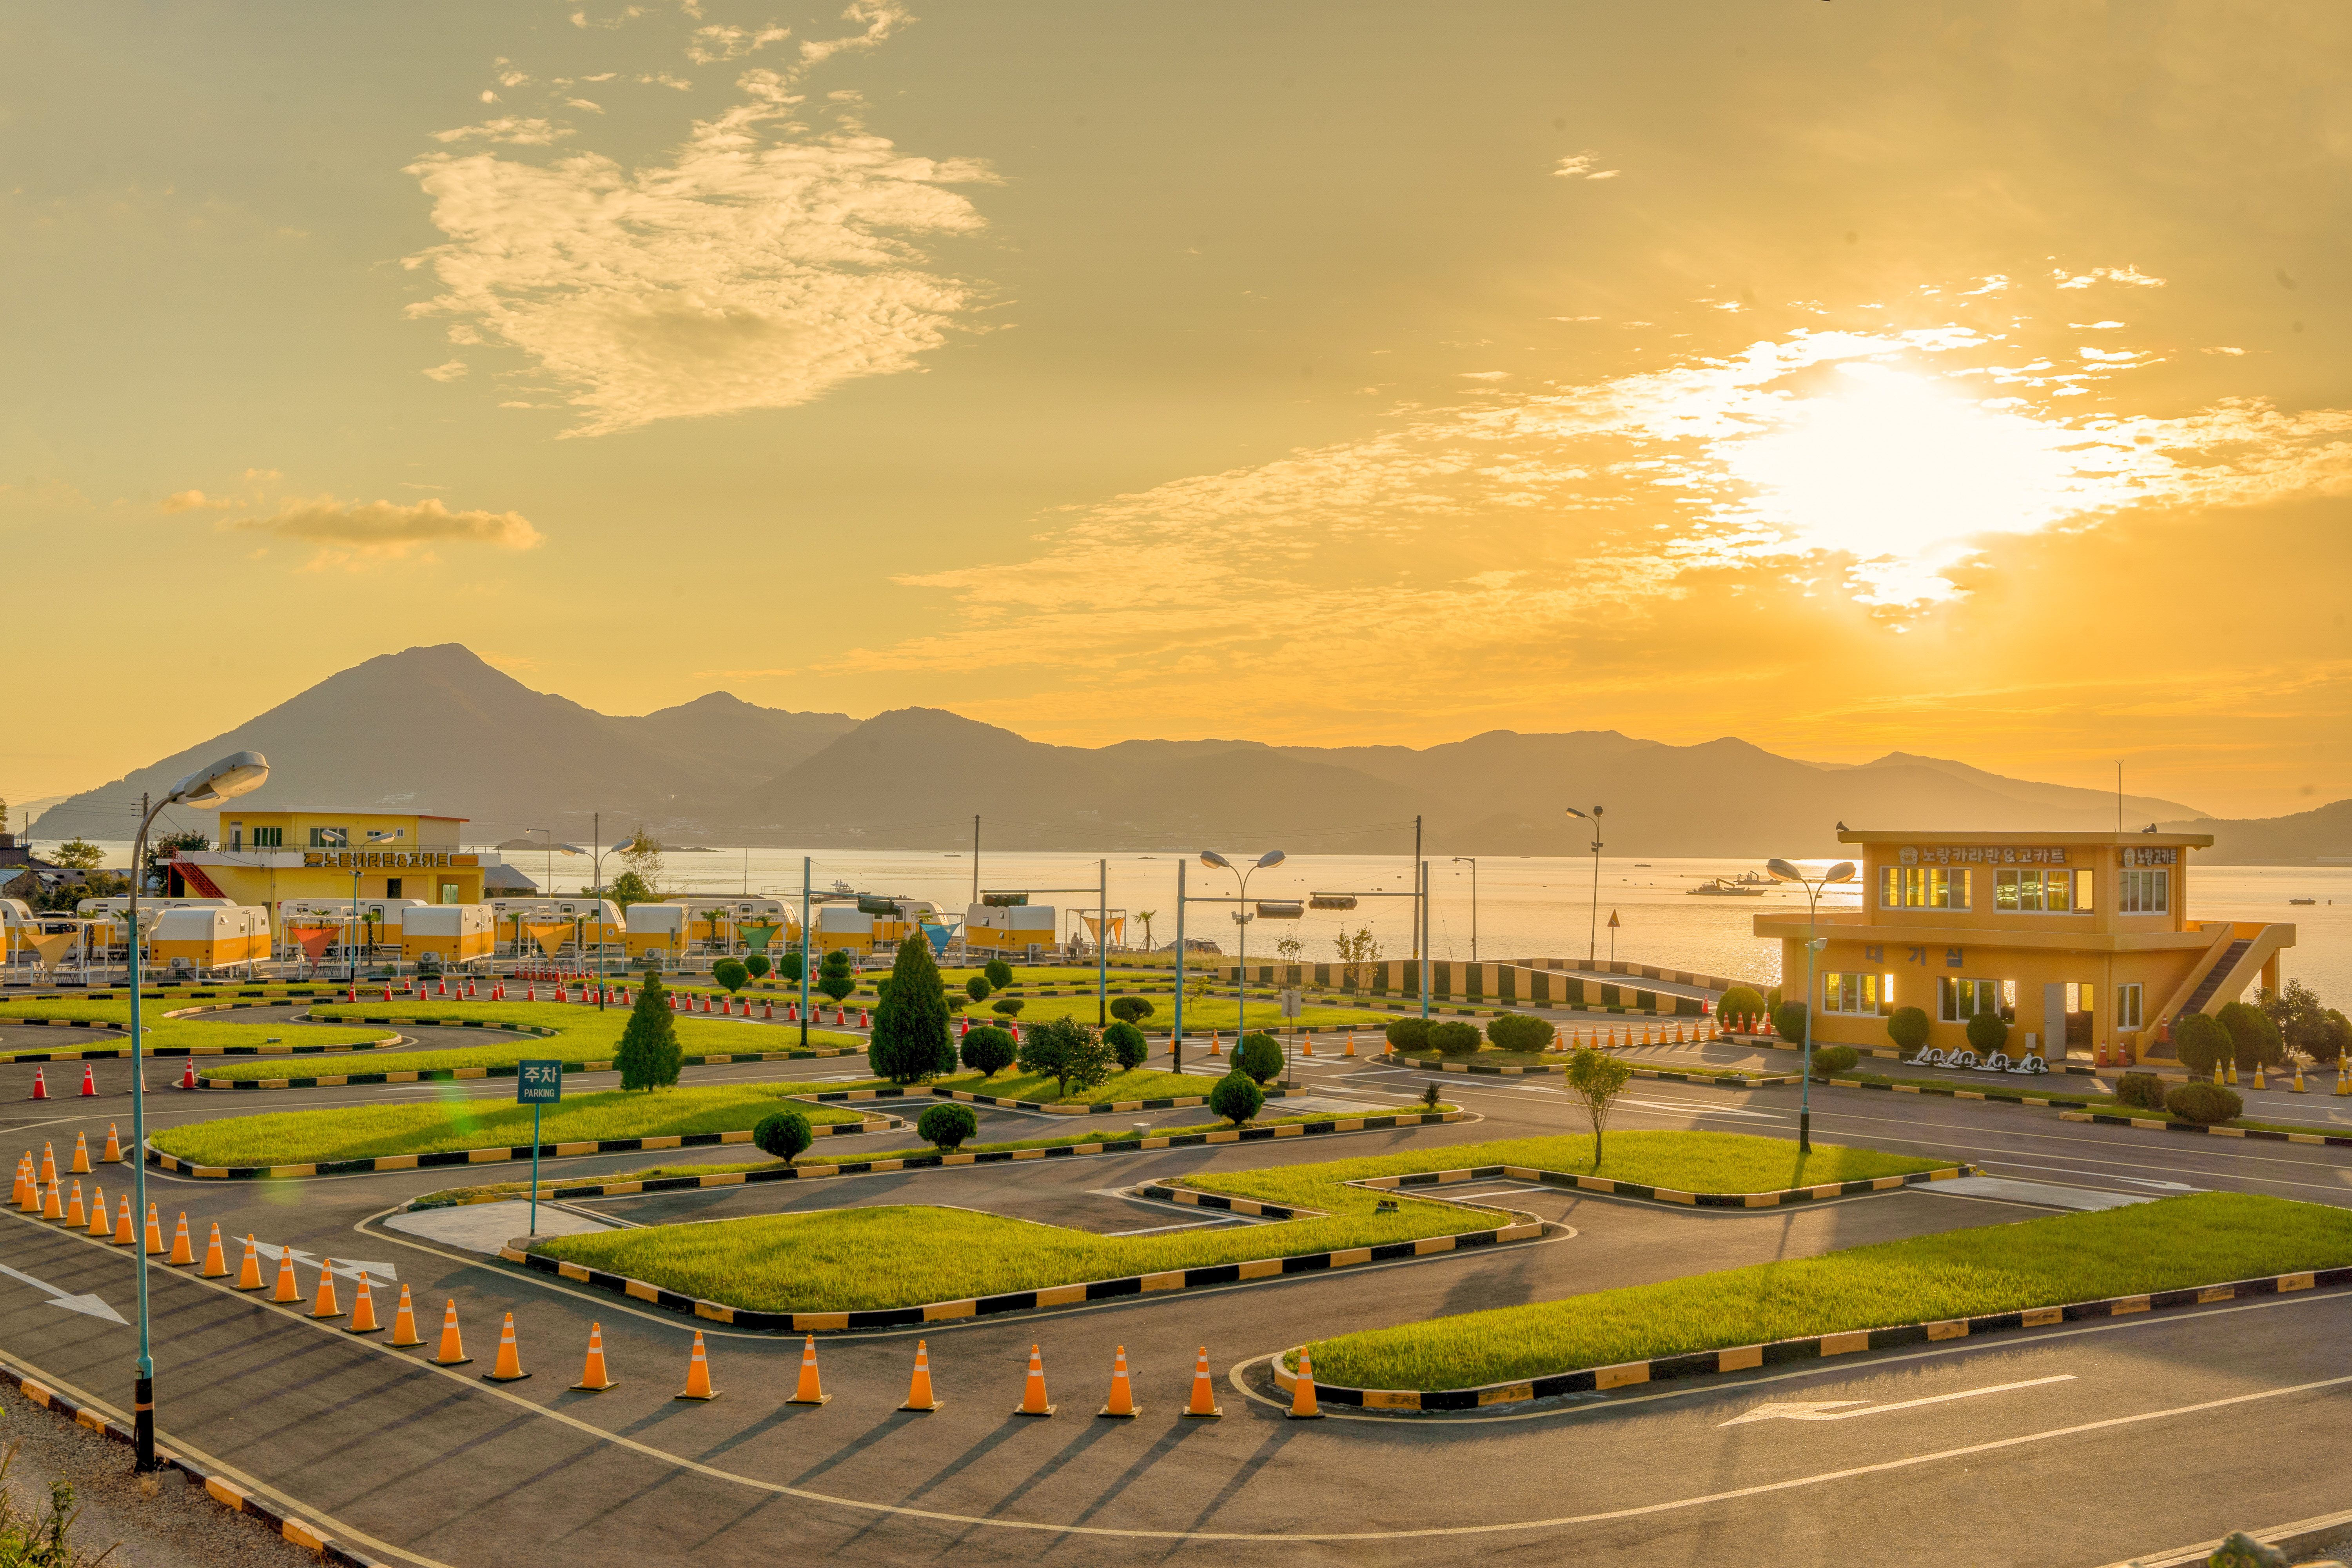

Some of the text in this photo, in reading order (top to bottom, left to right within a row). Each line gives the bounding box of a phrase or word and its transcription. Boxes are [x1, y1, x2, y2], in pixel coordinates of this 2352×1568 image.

[2137, 849, 2177, 866] 노랑고카트
[1865, 945, 1963, 968] 대기실
[524, 1067, 557, 1083] 주차
[524, 1089, 554, 1097] PARKING
